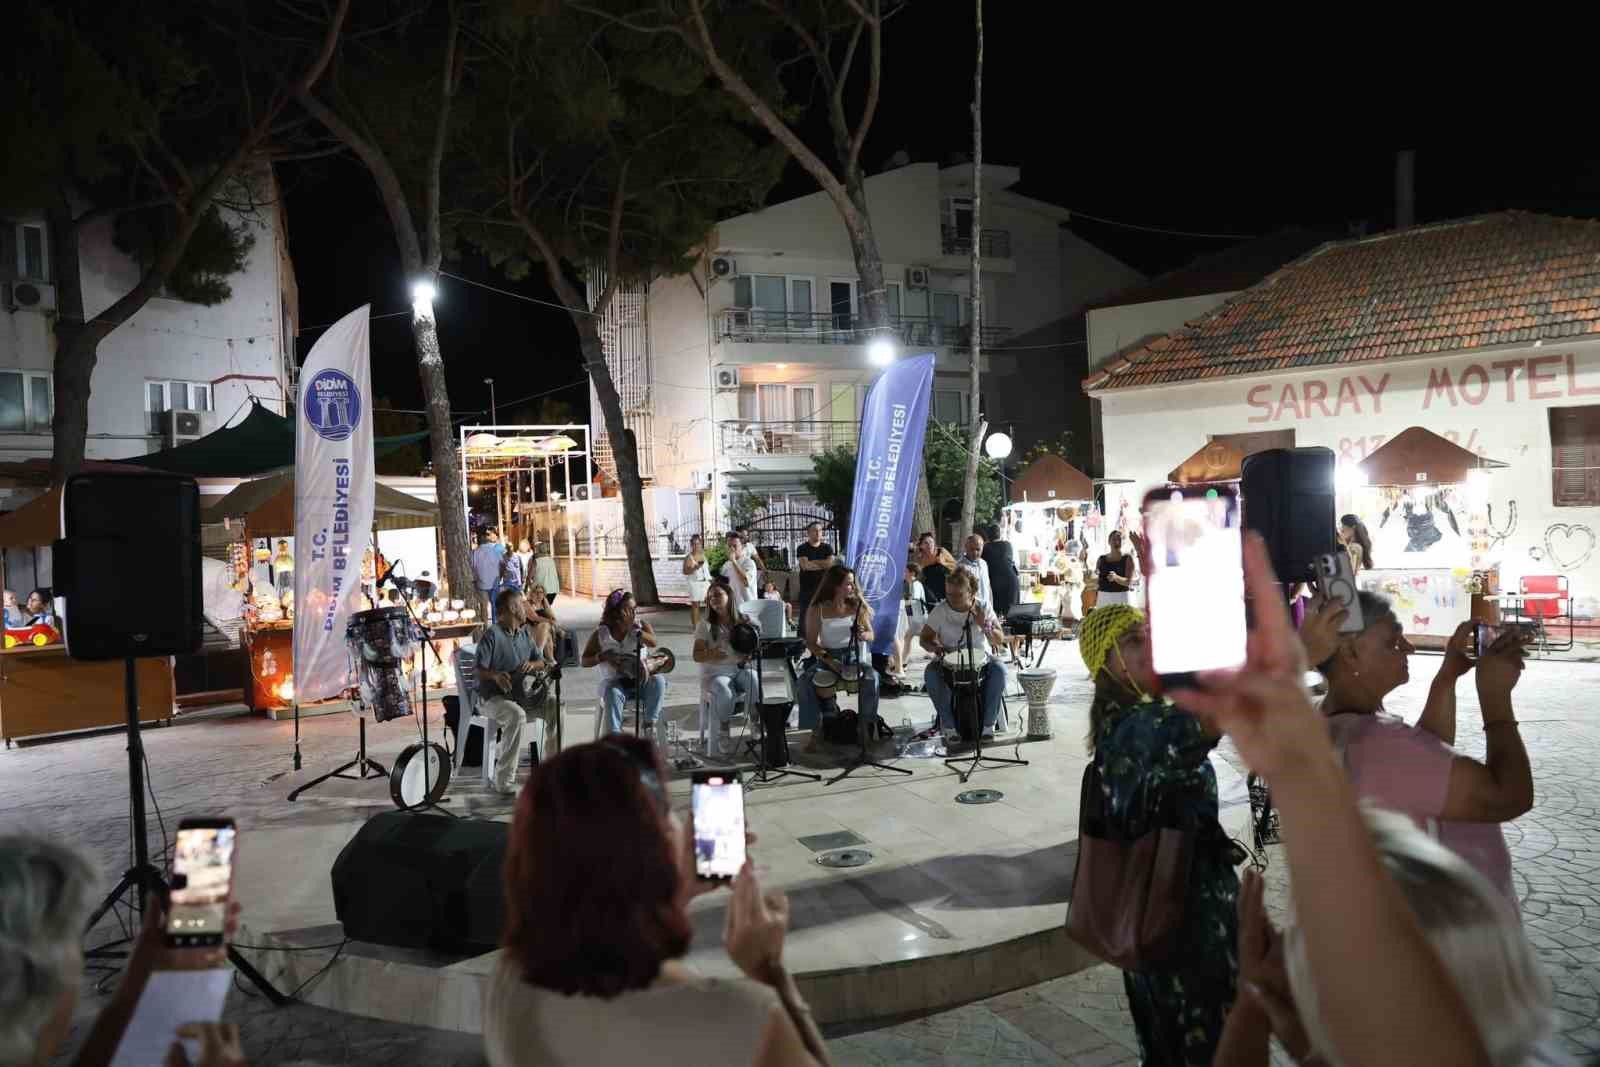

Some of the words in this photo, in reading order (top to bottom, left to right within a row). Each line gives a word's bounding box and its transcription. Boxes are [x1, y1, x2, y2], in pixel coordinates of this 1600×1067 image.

[1247, 372, 1391, 423] SARAY
[1422, 353, 1600, 410] MOTEL
[884, 404, 907, 490] BELEDİYESİ
[866, 455, 882, 483] T.C.
[876, 495, 894, 538] DİDİM
[311, 528, 328, 562] T.C.
